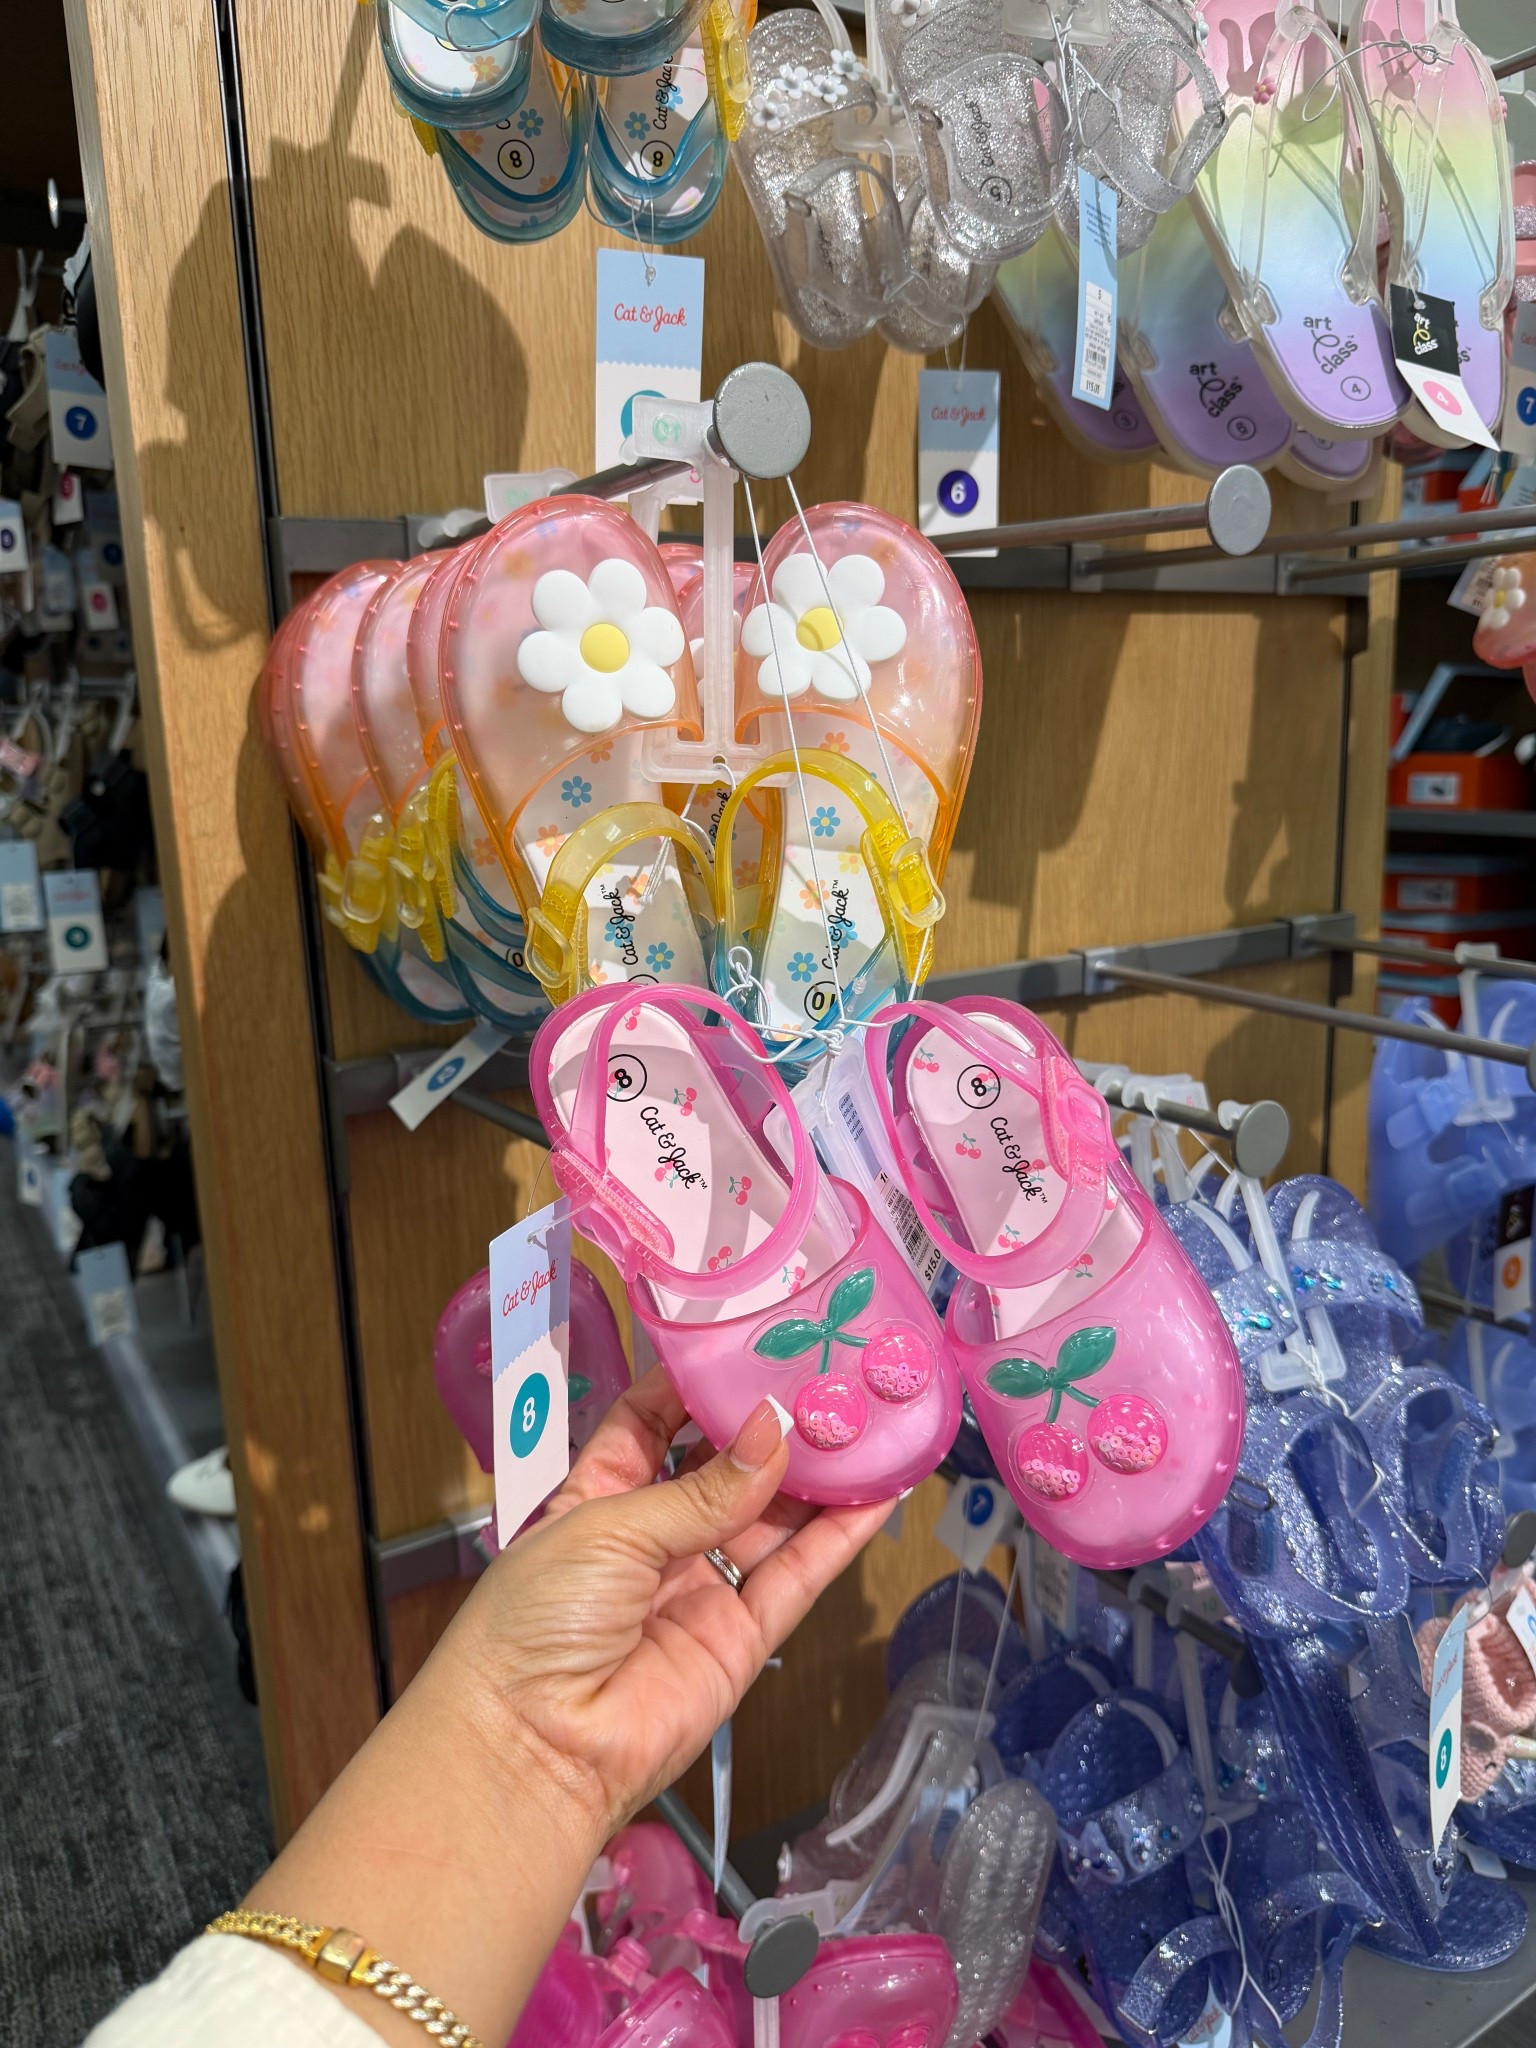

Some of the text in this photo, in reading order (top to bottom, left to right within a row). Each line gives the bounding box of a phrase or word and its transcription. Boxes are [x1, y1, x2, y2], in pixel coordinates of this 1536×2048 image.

[653, 106, 669, 130] Cat
[510, 150, 522, 168] 8
[653, 150, 663, 166] 8
[614, 303, 687, 333] Cat & Jack
[1303, 316, 1332, 331] art
[1413, 312, 1431, 329] art
[1414, 338, 1438, 356] class
[1320, 340, 1358, 375] class
[1189, 361, 1217, 377] art
[1351, 383, 1362, 395] 4
[1435, 391, 1449, 407] 4
[1207, 381, 1243, 419] class
[1526, 396, 1535, 414] 7
[75, 414, 88, 432] 7
[931, 406, 948, 421] Cat
[960, 404, 987, 428] Jack
[950, 478, 966, 505] 6
[615, 926, 631, 939] &
[830, 925, 843, 942] &
[622, 942, 639, 966] Cat
[614, 1068, 633, 1088] 8
[970, 1077, 987, 1097] 8
[640, 1106, 667, 1136] Cat
[657, 1132, 677, 1149] &
[990, 1116, 1014, 1145] Cat
[1003, 1144, 1022, 1160] &
[924, 1247, 941, 1281] $15.0
[502, 1260, 558, 1317] Cat & Jack
[522, 1396, 536, 1433] 8
[1440, 1745, 1447, 1767] 8
